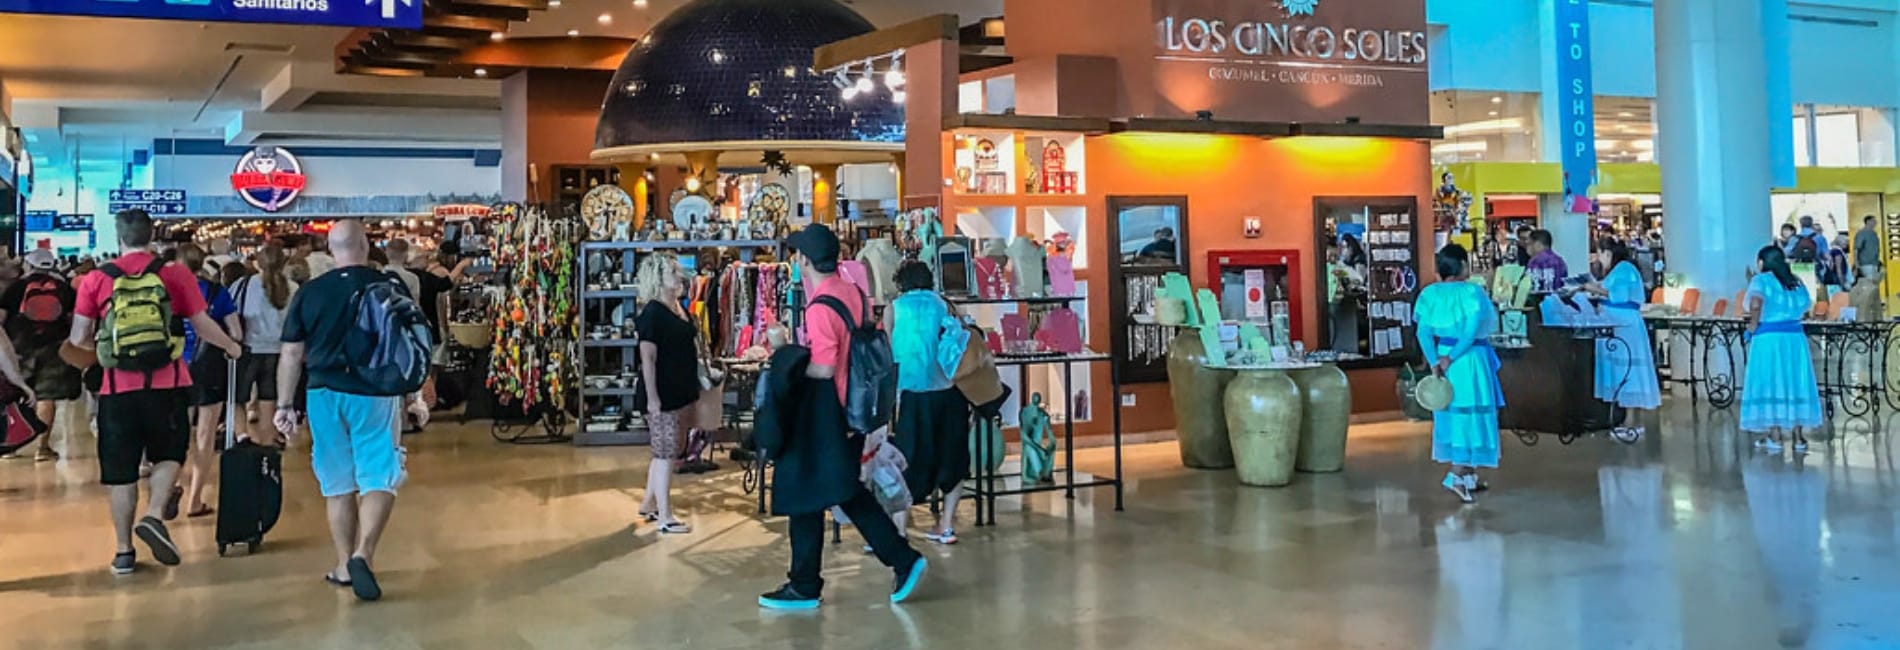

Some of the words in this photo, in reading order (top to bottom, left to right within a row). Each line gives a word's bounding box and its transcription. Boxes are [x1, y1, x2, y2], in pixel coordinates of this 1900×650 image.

[232, 0, 328, 11] Sanitarios
[1165, 16, 1227, 53] LOS
[1232, 22, 1336, 59] CINCO
[1343, 28, 1426, 64] SOLES
[1569, 22, 1583, 61] TO
[1572, 78, 1586, 158] SHOP
